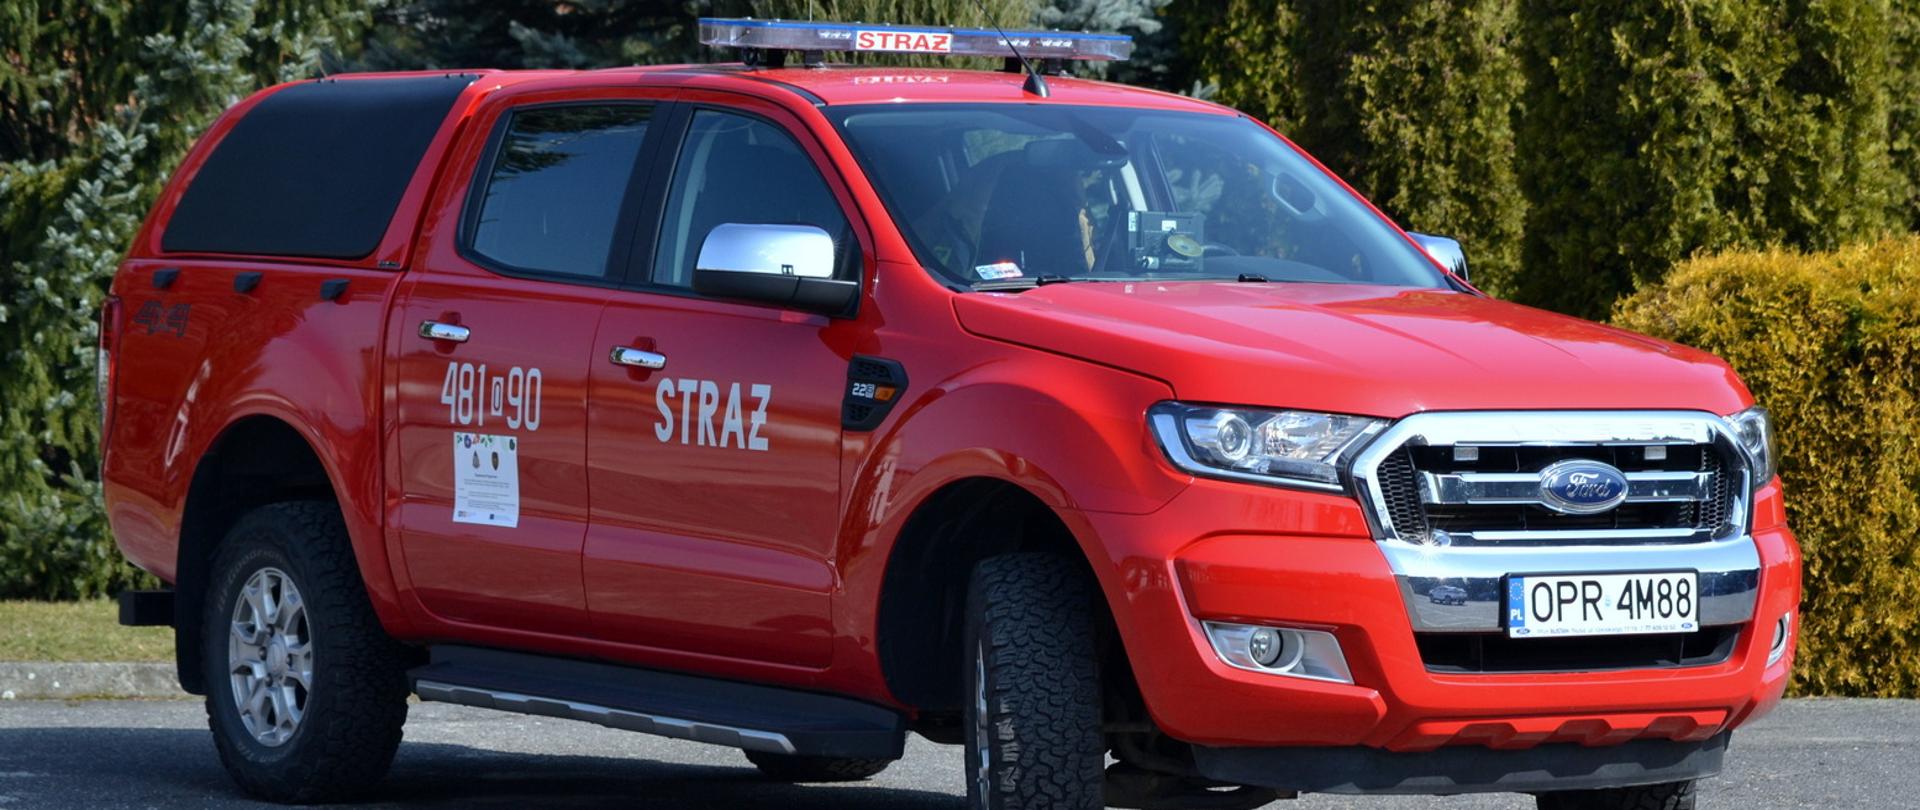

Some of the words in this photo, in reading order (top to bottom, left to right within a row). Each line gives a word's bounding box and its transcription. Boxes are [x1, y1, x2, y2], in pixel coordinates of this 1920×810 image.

[441, 361, 486, 427] 481
[506, 366, 542, 431] 90
[1566, 471, 1612, 499] Ford
[1510, 608, 1524, 621] PL
[1531, 581, 1603, 622] OPR
[1617, 578, 1691, 619] 4M88
